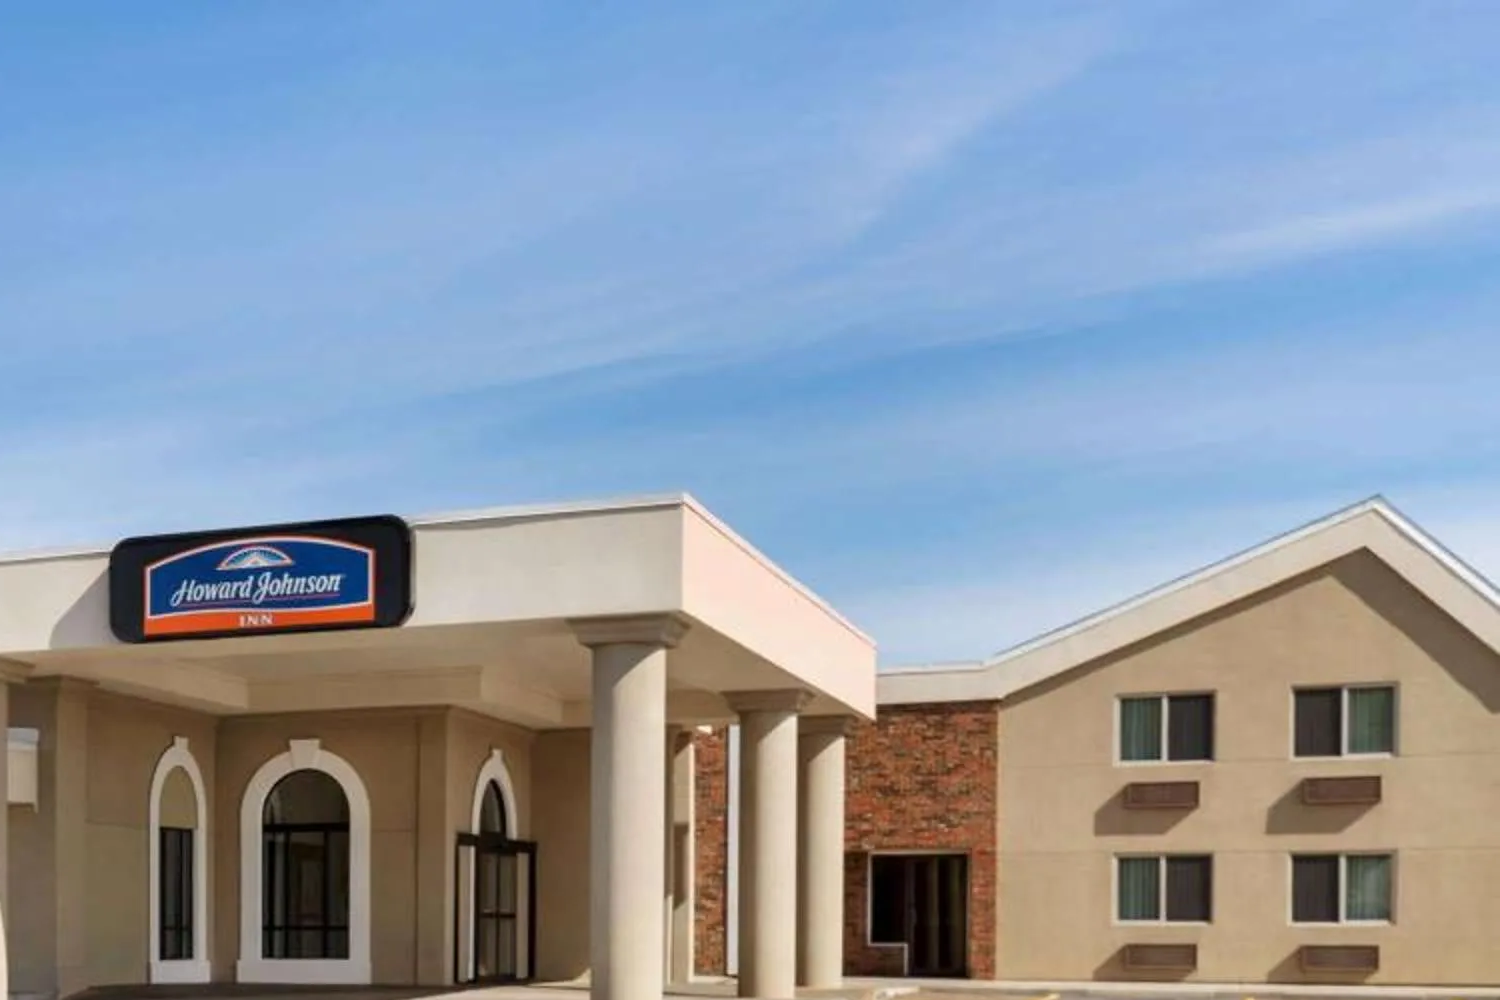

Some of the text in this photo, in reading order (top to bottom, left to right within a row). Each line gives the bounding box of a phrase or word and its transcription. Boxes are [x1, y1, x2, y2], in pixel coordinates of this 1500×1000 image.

[170, 571, 342, 607] Howard Johnson
[238, 612, 274, 628] INN
